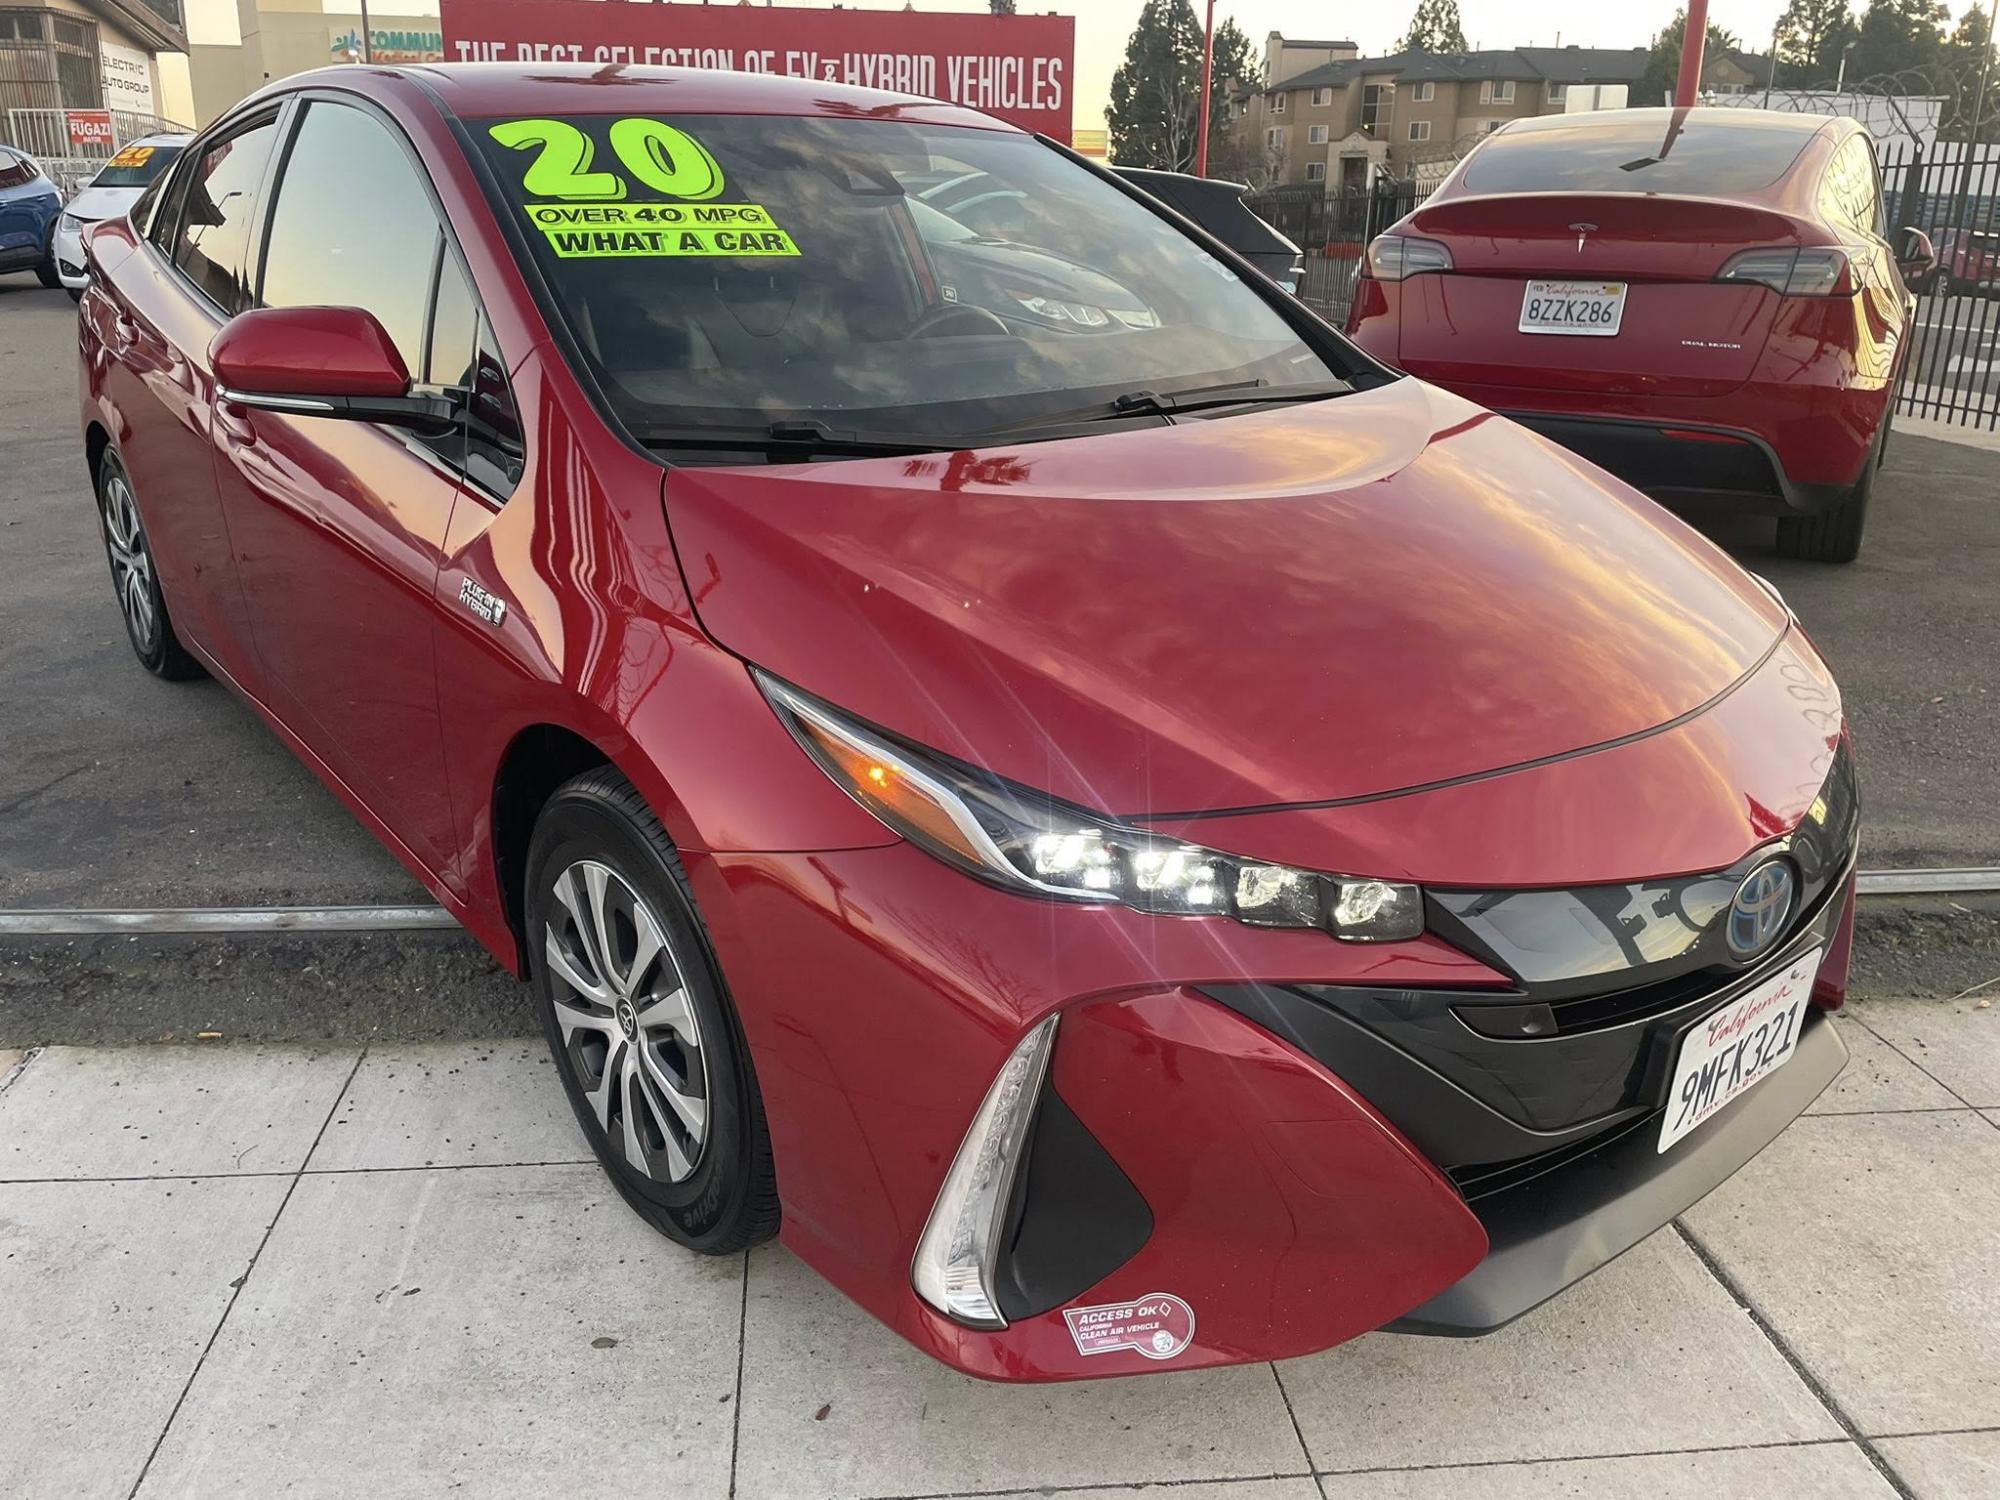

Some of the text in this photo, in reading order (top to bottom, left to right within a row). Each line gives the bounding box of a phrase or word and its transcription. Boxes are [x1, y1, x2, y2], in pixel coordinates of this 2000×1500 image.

[103, 56, 144, 75] ELECTRIC
[124, 80, 149, 93] GROUP
[947, 55, 1063, 110] VEHICLES
[71, 122, 110, 136] FUGAZI
[488, 118, 725, 200] 20
[535, 207, 764, 223] OVER 40 MPG
[553, 231, 785, 252] WHAT A CAR
[1528, 298, 1615, 323] 8ZZK286
[1708, 985, 1792, 1048] California
[1673, 1000, 1799, 1131] 9MFK321
[1079, 1306, 1159, 1325] ACCESS OK
[1079, 1322, 1112, 1332] CALIFORNIA
[1080, 1322, 1159, 1340] CLEAN AIR VEHICLE
